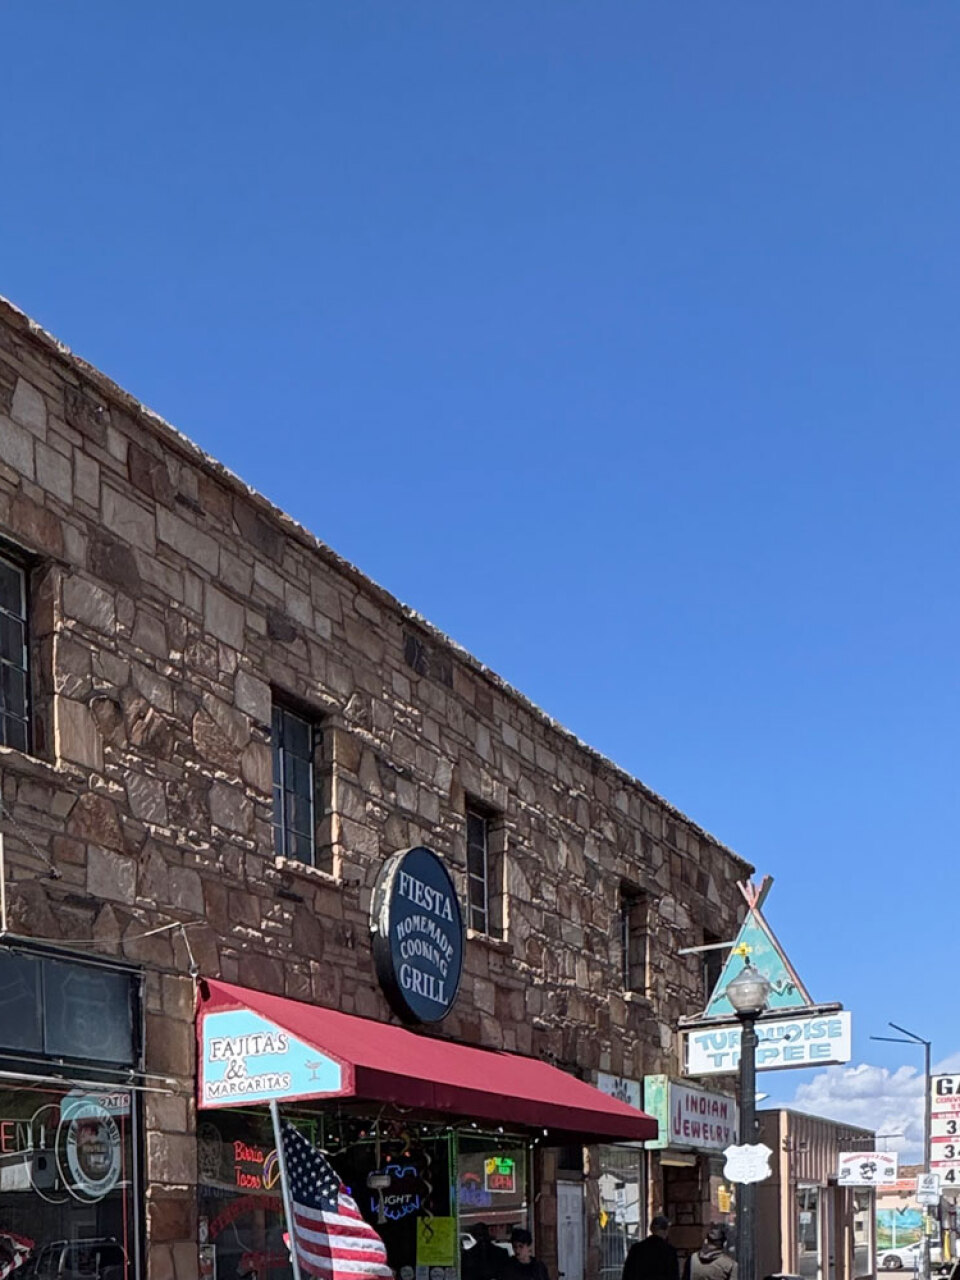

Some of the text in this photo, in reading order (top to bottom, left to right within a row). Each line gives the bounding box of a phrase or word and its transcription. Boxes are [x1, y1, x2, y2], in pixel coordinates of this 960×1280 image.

[398, 870, 454, 923] FIESTA
[396, 914, 454, 963] HOMEMADE
[400, 938, 448, 978] COOKING
[400, 963, 449, 1006] GRILL
[211, 1033, 288, 1058] FAJITAS
[227, 1059, 244, 1080] &
[208, 1076, 289, 1097] MARGARITAS
[936, 1078, 960, 1096] G
[673, 1102, 730, 1143] JEWELRY
[685, 1093, 728, 1120] INDIAN
